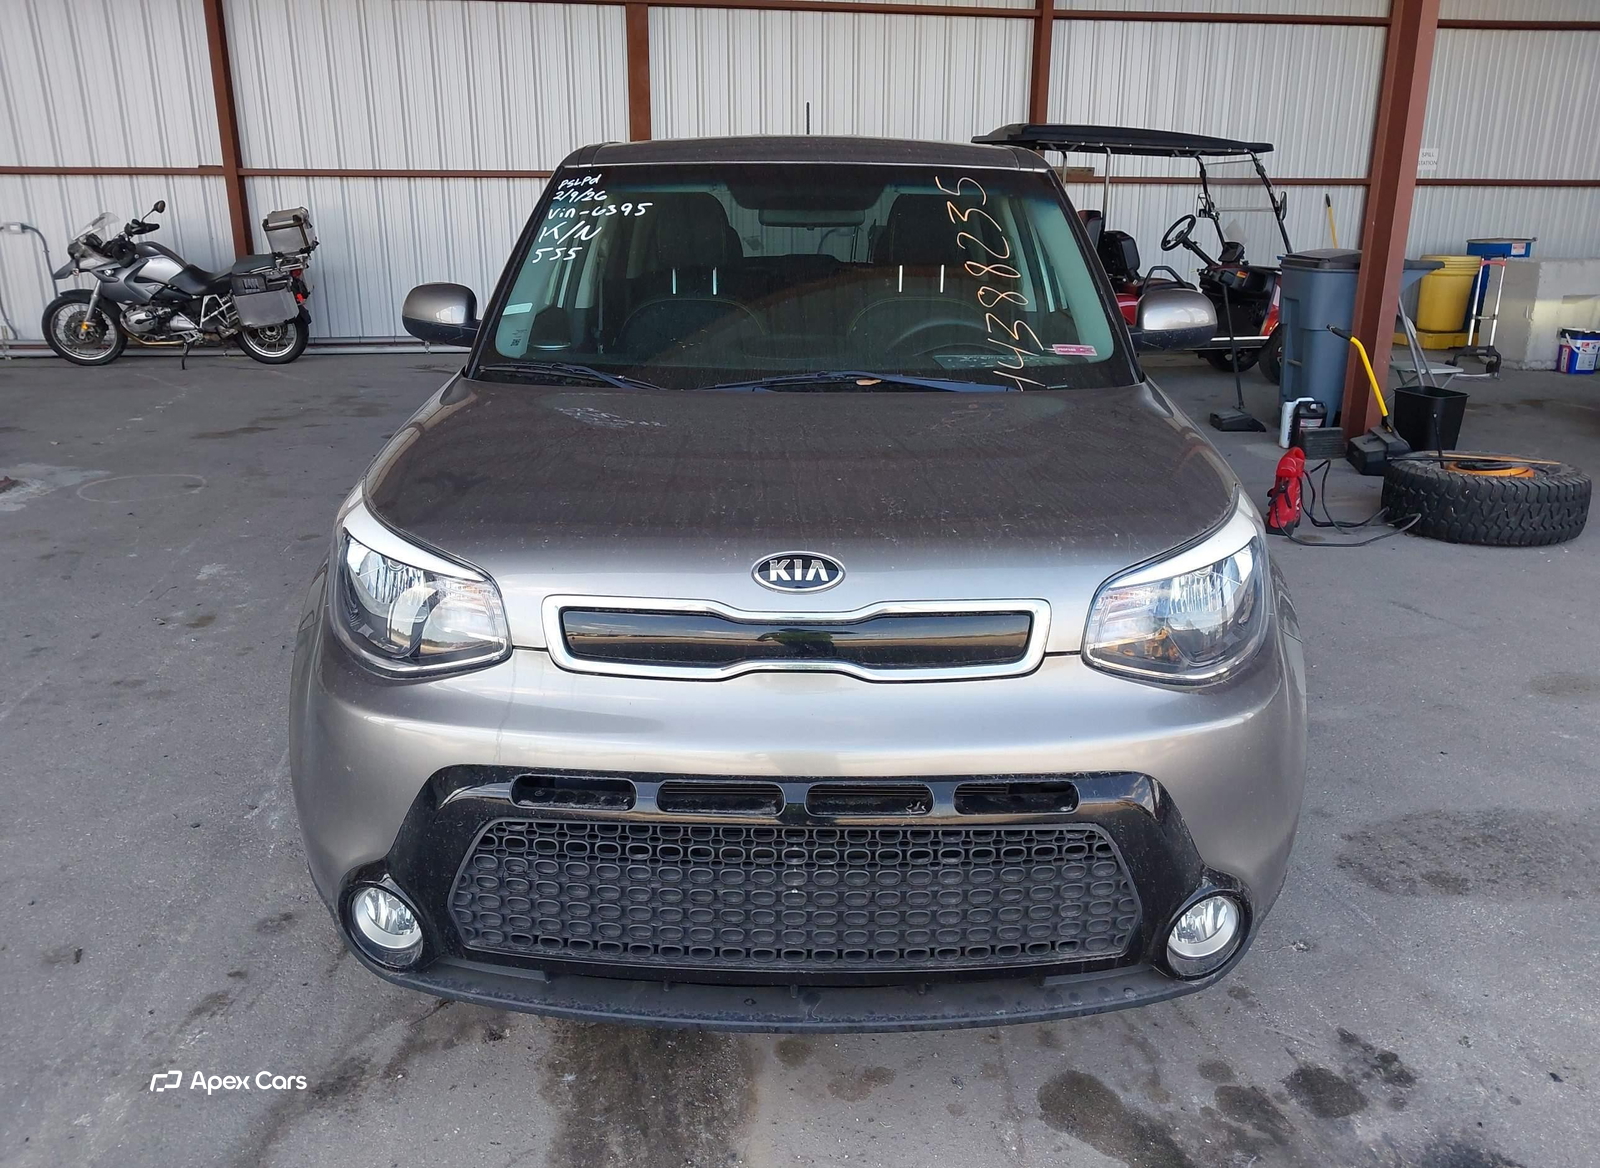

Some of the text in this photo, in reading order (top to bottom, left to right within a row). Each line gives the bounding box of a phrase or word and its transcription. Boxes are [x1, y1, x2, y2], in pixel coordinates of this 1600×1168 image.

[552, 187, 608, 203] 2/9/26
[532, 246, 583, 264] 555
[768, 558, 829, 582] KIA
